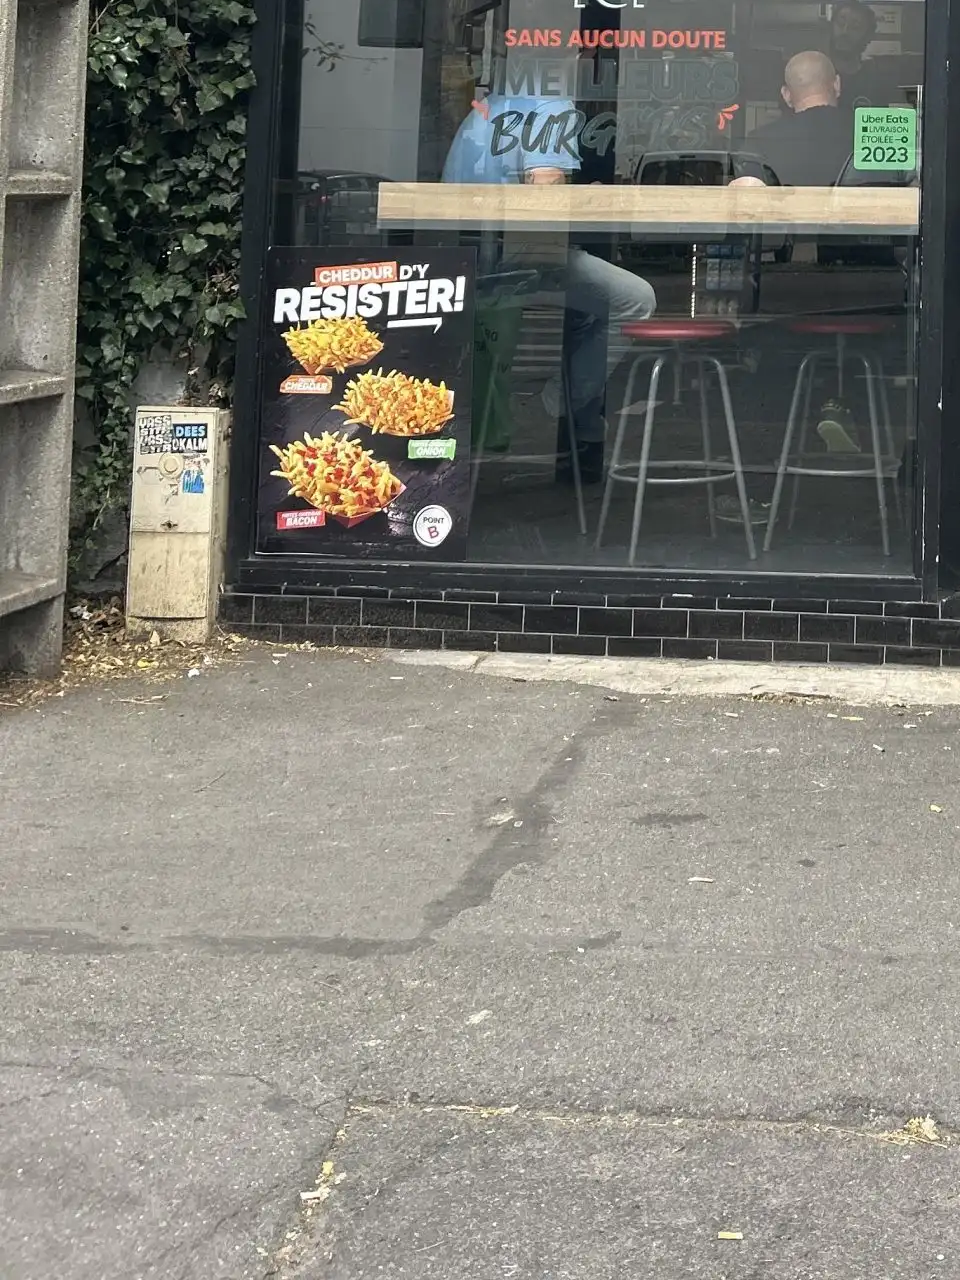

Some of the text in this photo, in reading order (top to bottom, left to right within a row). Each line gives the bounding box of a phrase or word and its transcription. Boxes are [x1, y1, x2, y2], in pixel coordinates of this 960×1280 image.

[504, 29, 726, 48] SANS AUCUN DOUTE
[862, 114, 909, 124] Uber Eats
[861, 134, 893, 143] ÉTOILÉE
[861, 146, 908, 163] 2023
[319, 263, 430, 284] CHEDDUR D'Y
[286, 516, 318, 527] BACON
[422, 516, 445, 524] POINT
[427, 525, 439, 539] B
